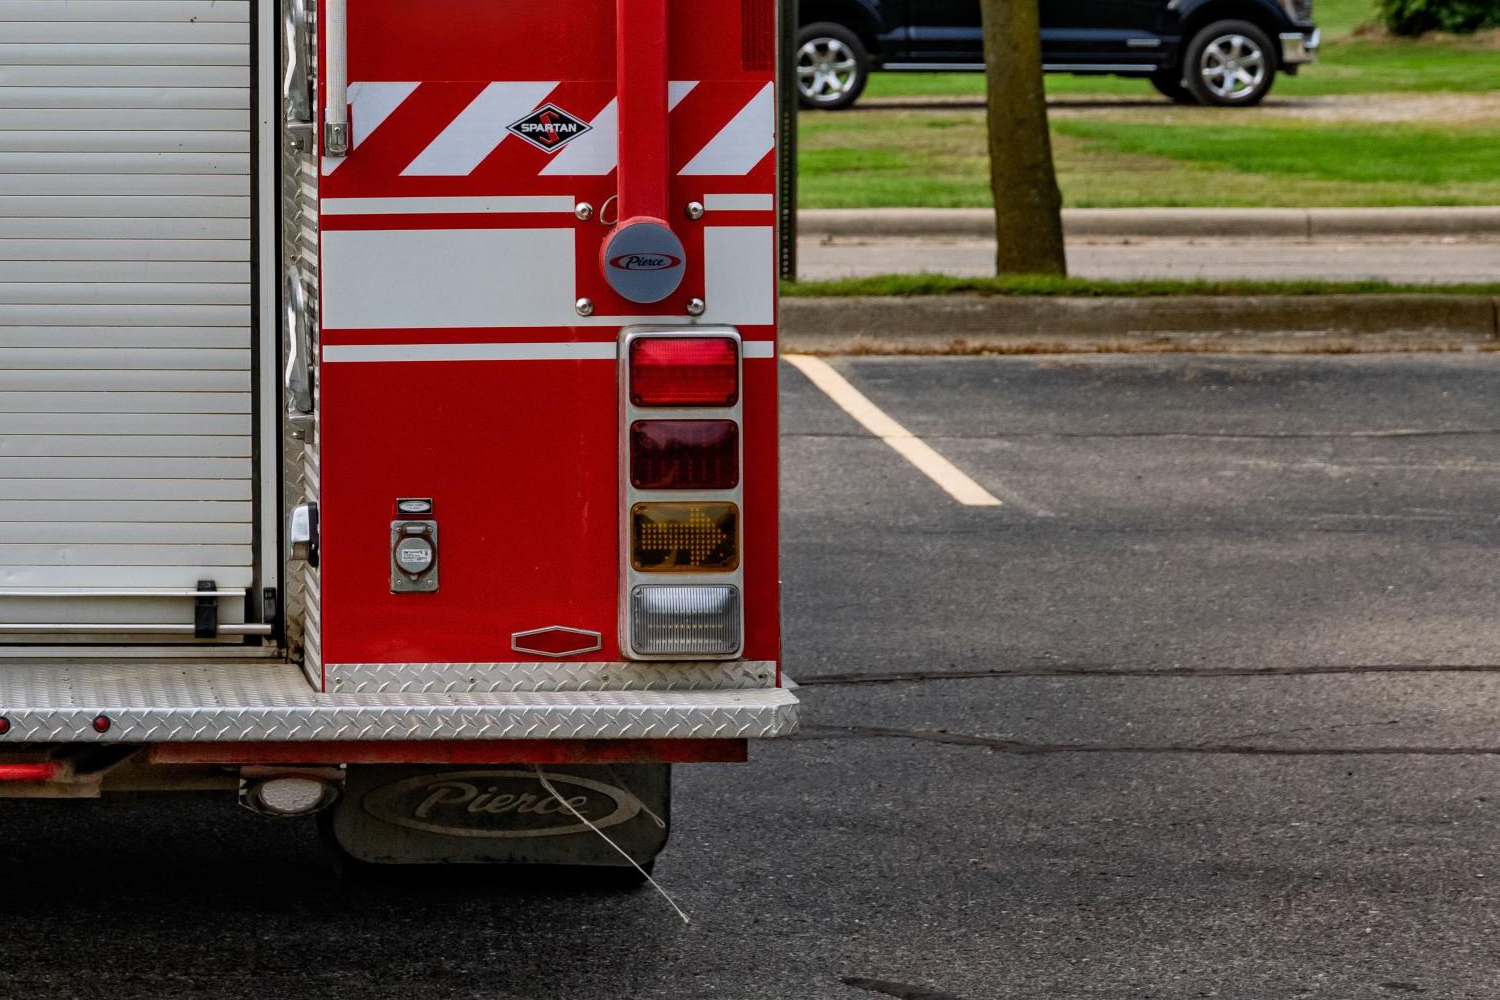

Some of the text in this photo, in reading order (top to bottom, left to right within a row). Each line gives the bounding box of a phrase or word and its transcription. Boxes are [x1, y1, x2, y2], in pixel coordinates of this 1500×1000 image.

[521, 123, 577, 133] SPARTAN
[625, 255, 664, 269] Pierce
[413, 781, 589, 819] Pierce
